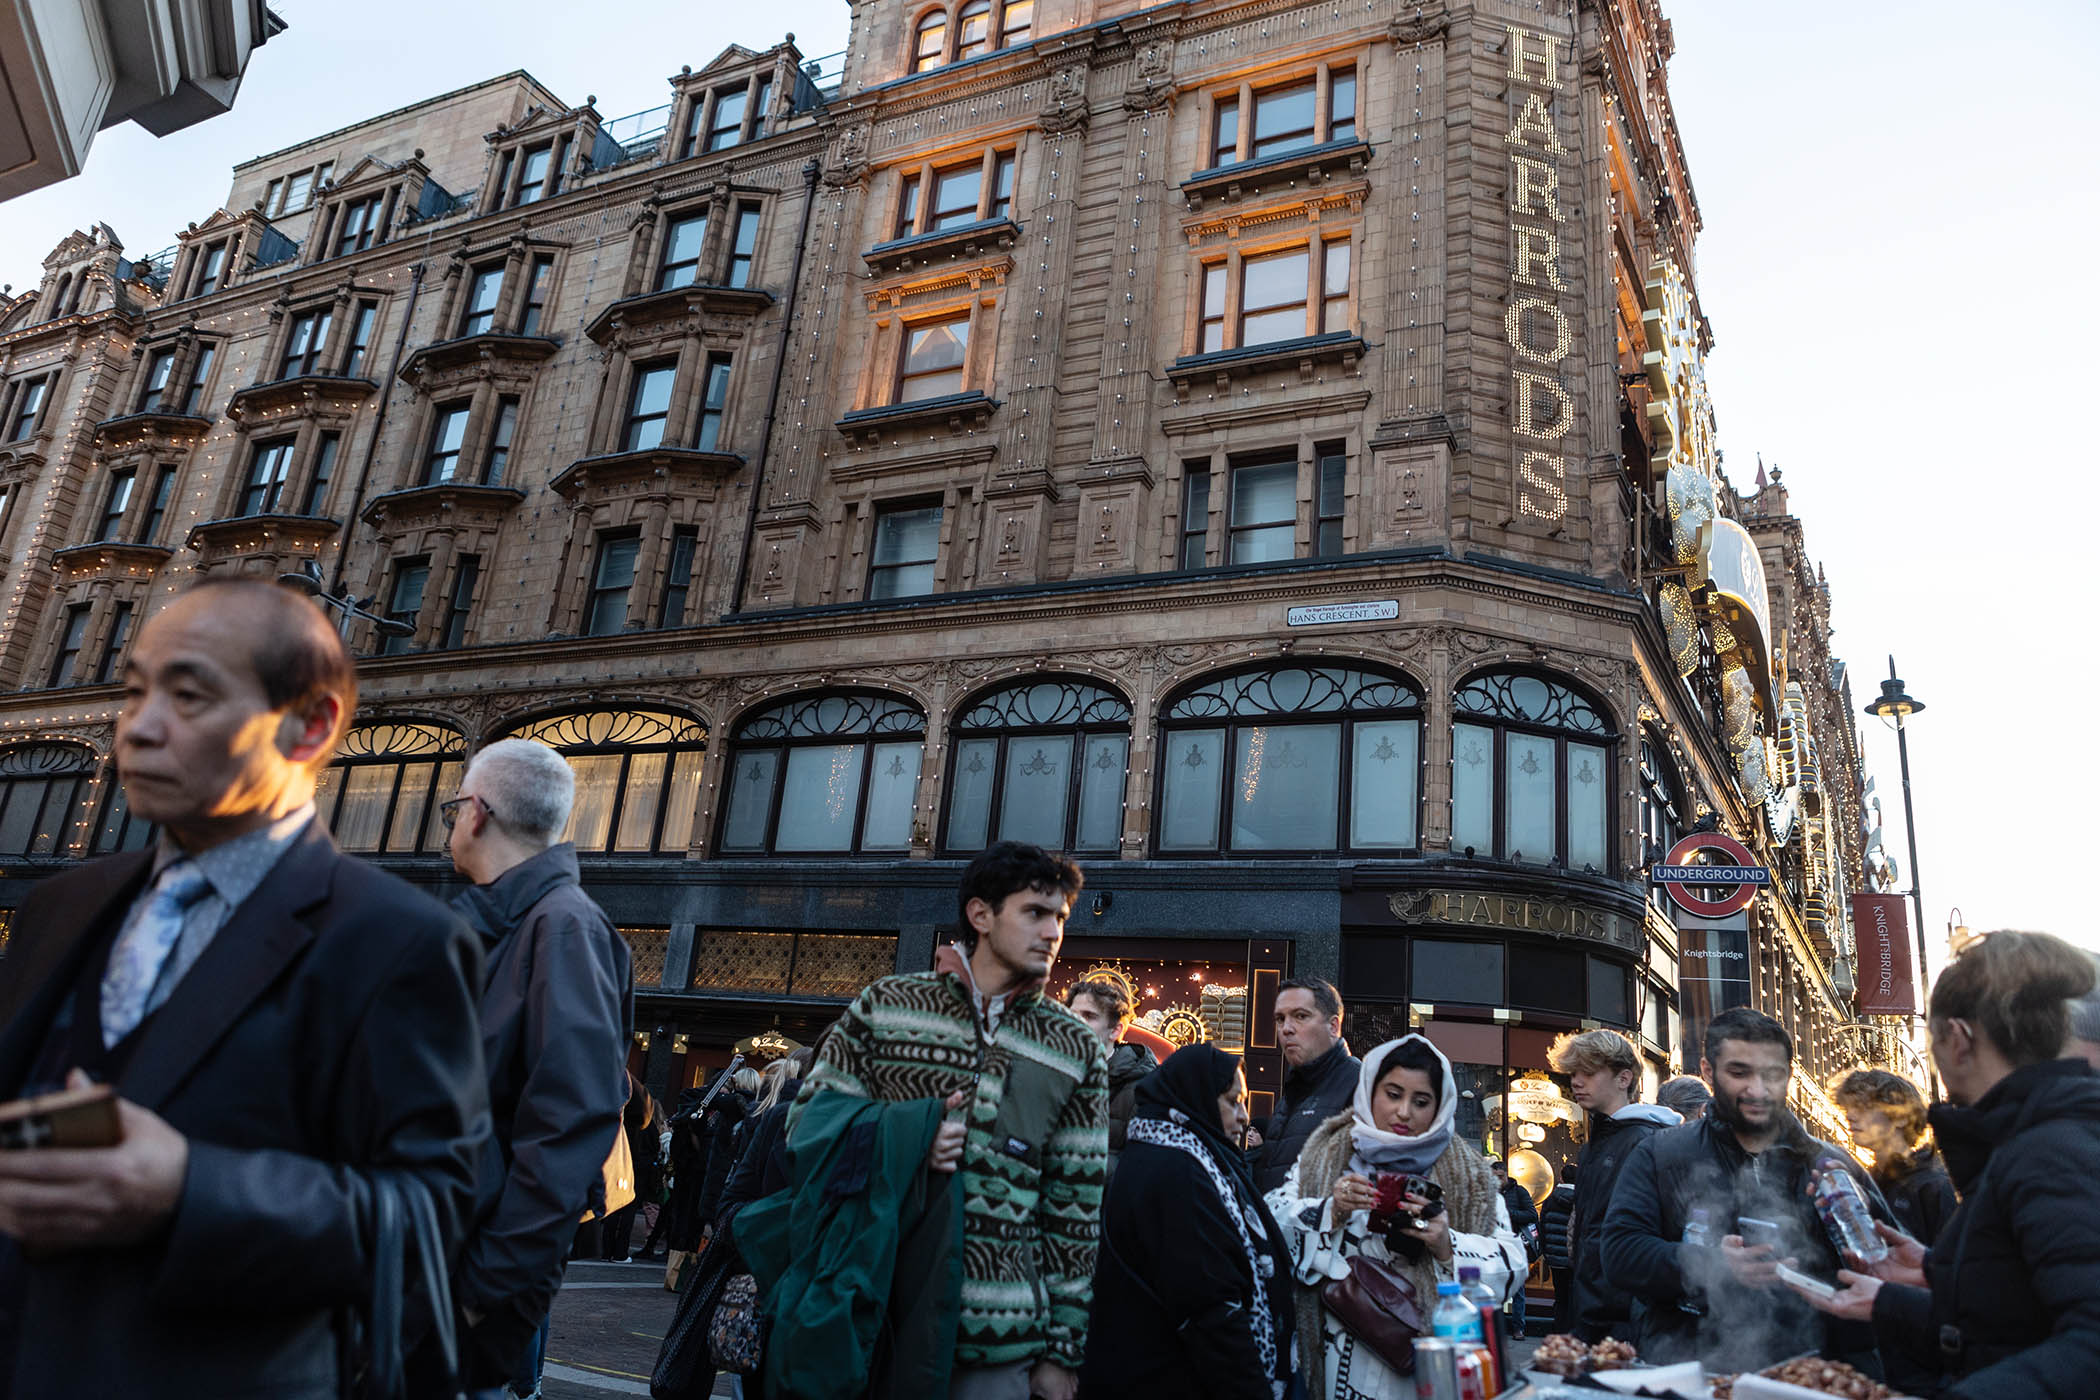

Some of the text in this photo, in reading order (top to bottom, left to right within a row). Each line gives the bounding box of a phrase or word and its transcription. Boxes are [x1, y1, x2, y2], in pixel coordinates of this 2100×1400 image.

[1504, 26, 1574, 521] HARRODS
[1290, 614, 1316, 624] HANS
[1657, 868, 1765, 880] UNDERGROUND
[1438, 893, 1606, 940] HARRODS
[1684, 949, 1744, 959] Knightsbridge
[1873, 905, 1892, 996] KNIGHTSBRIDGE
